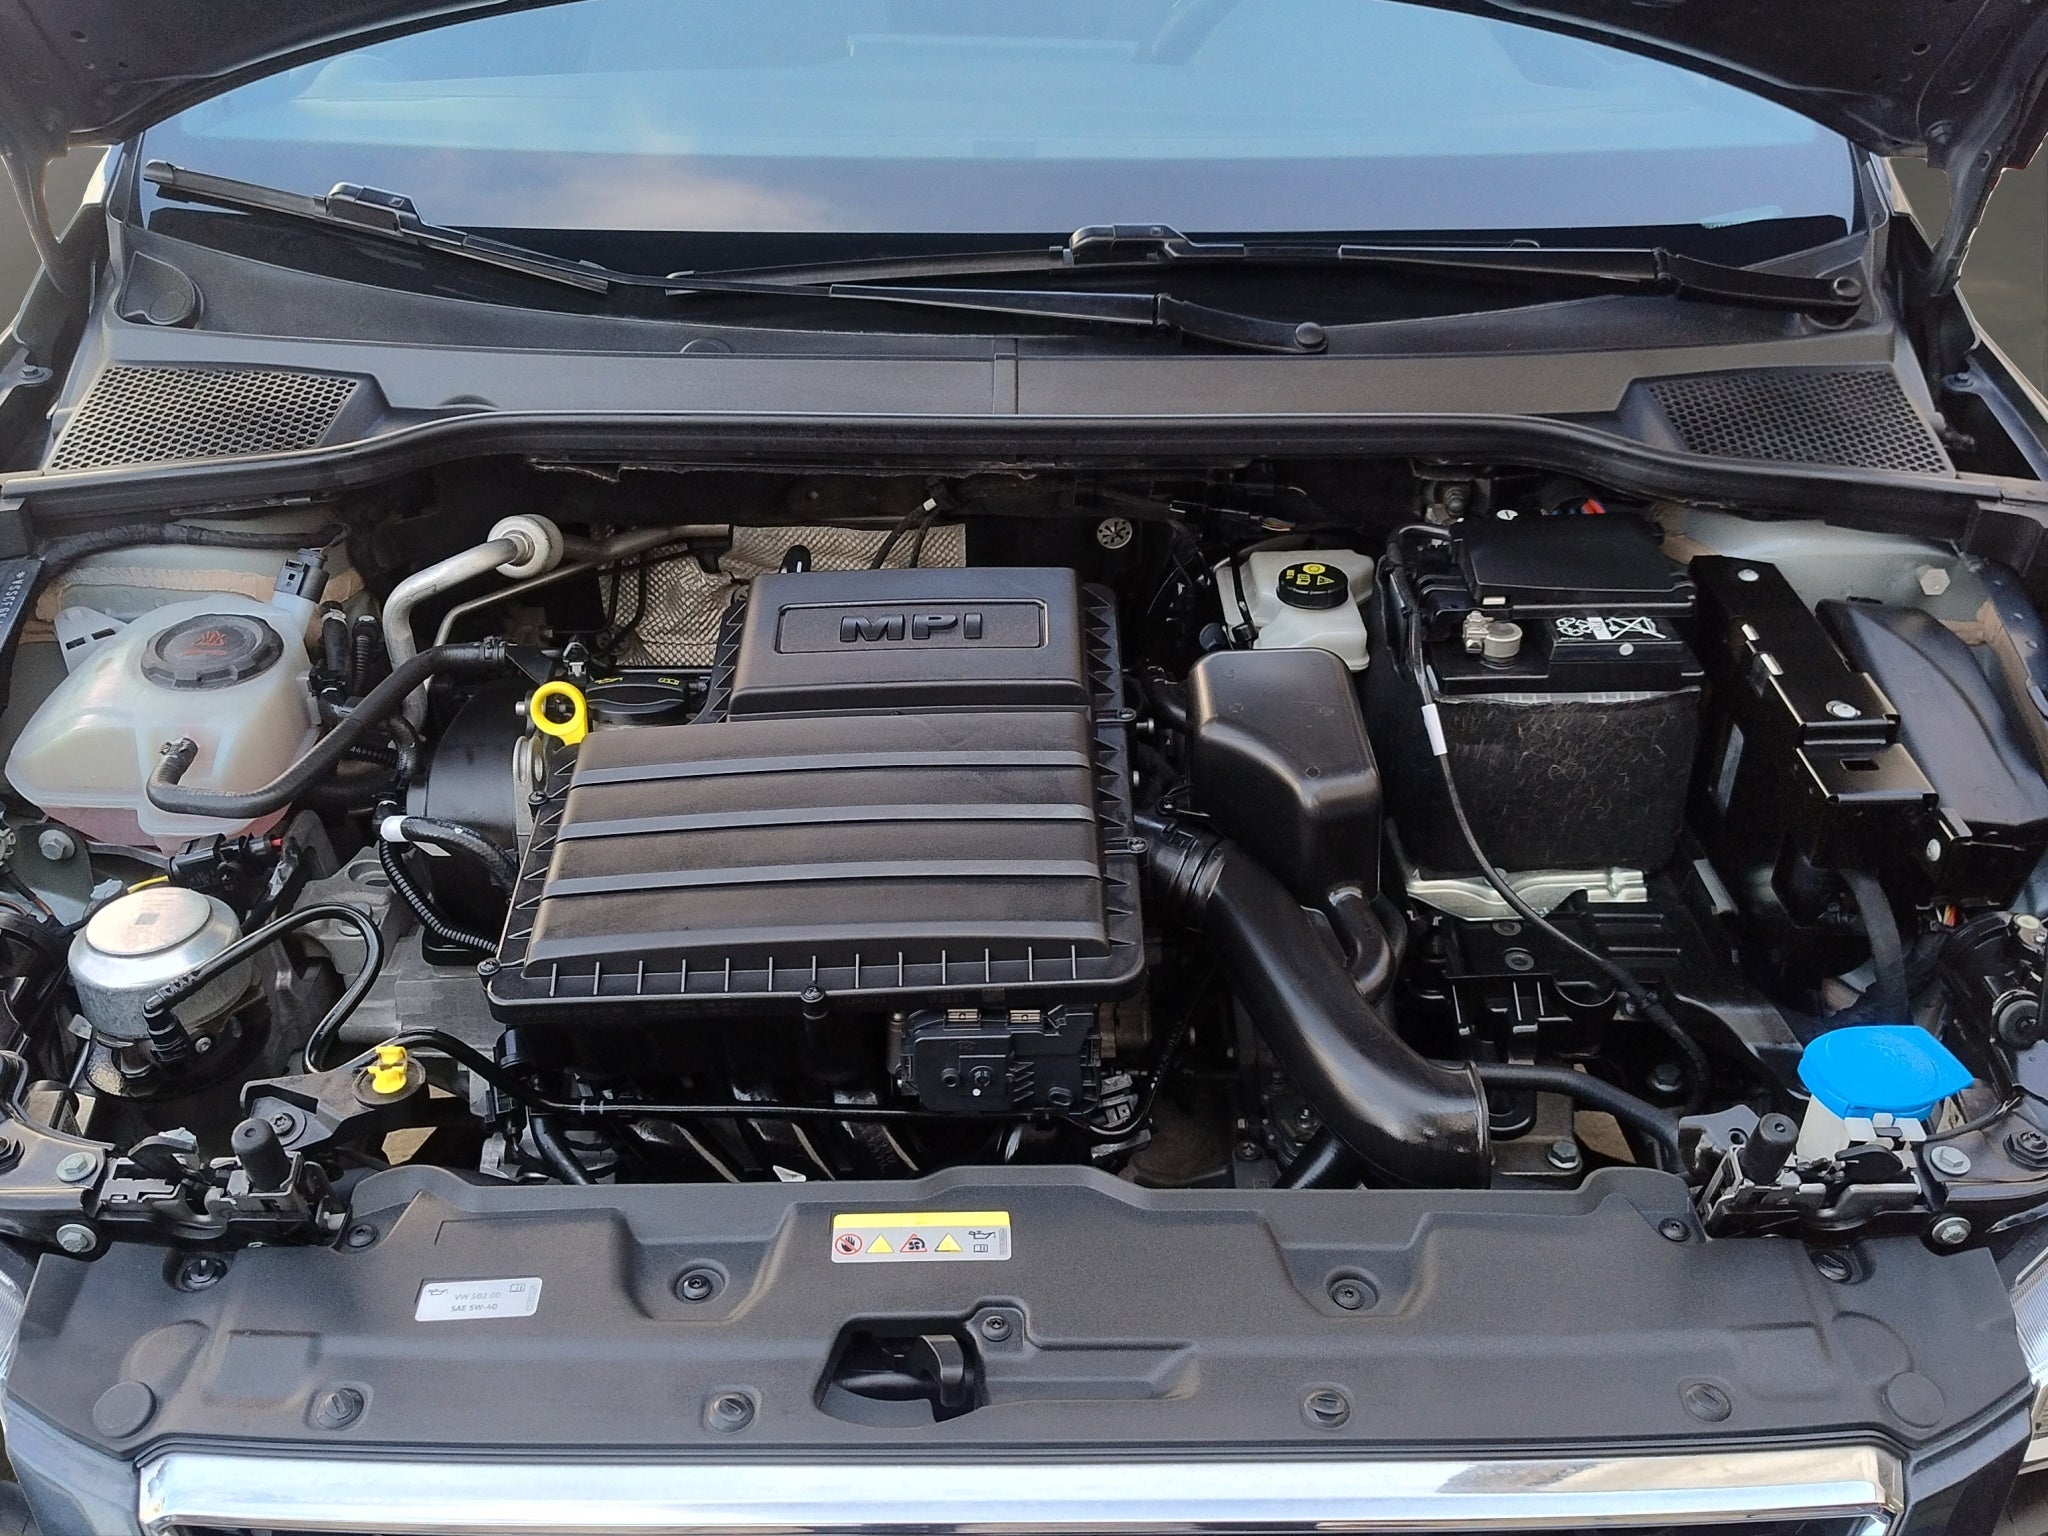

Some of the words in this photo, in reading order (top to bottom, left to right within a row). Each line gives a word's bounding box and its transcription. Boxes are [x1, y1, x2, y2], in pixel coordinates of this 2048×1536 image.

[840, 613, 983, 642] MPI
[454, 1293, 469, 1301] VW
[469, 1303, 498, 1311] 5W-40
